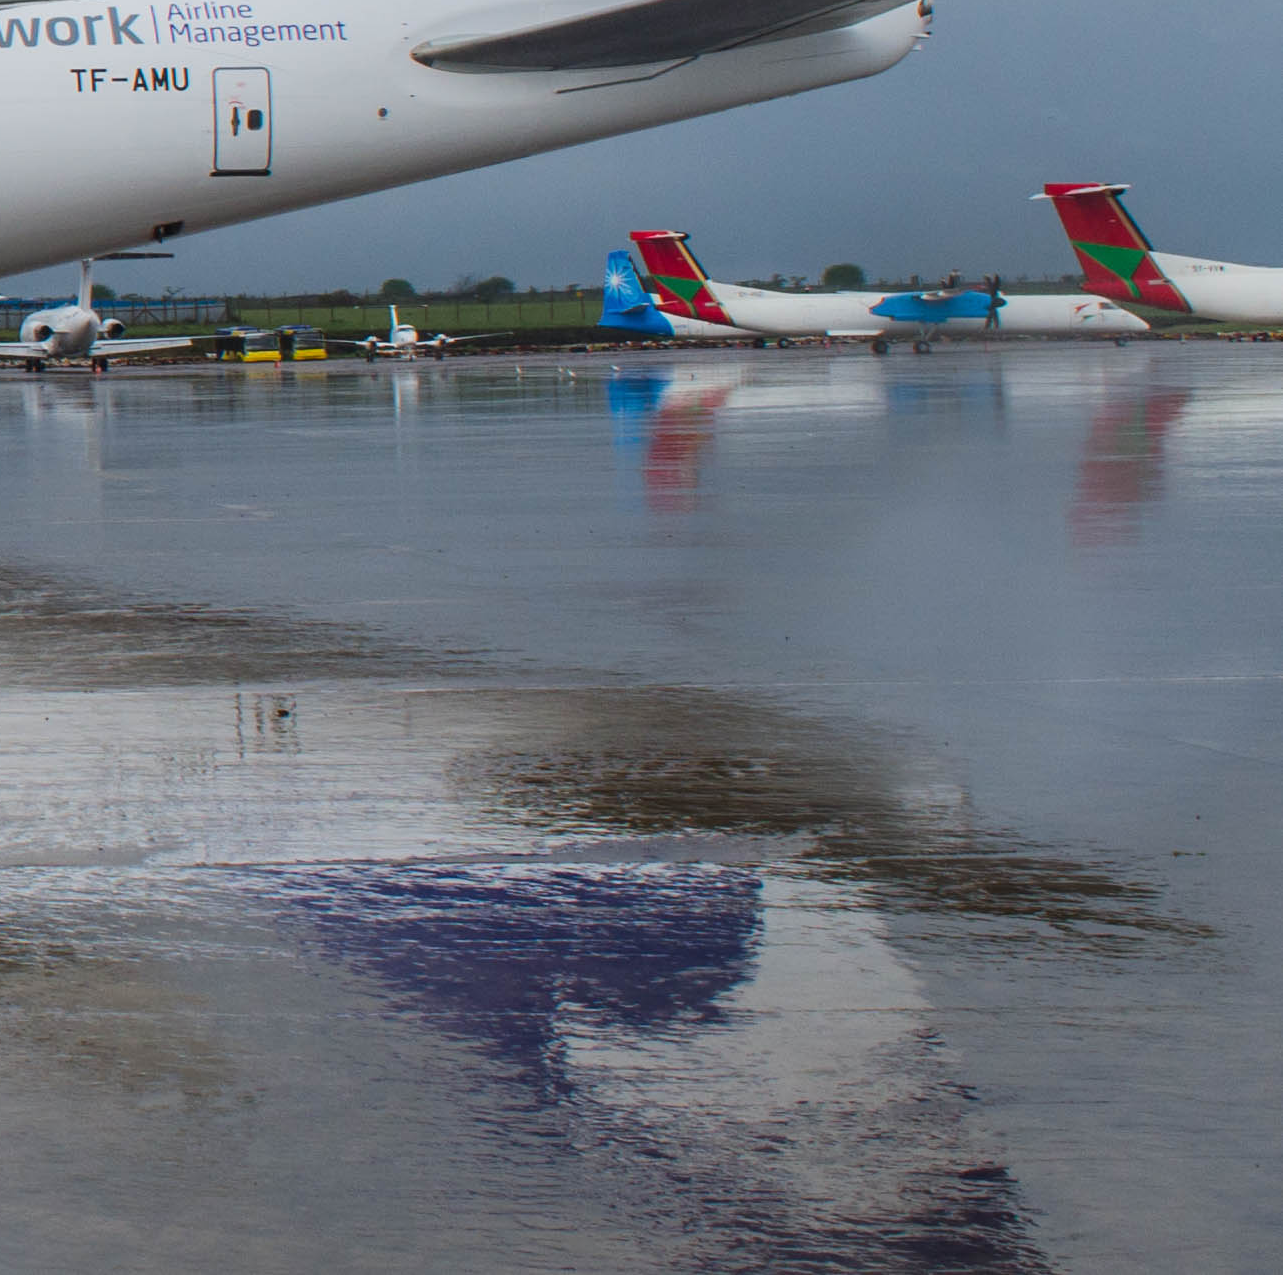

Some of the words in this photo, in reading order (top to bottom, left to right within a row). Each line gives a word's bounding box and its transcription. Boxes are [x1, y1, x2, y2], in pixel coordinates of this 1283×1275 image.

[167, 1, 253, 21] Airline
[168, 21, 348, 47] Management
[70, 67, 190, 92] TF-AMU
